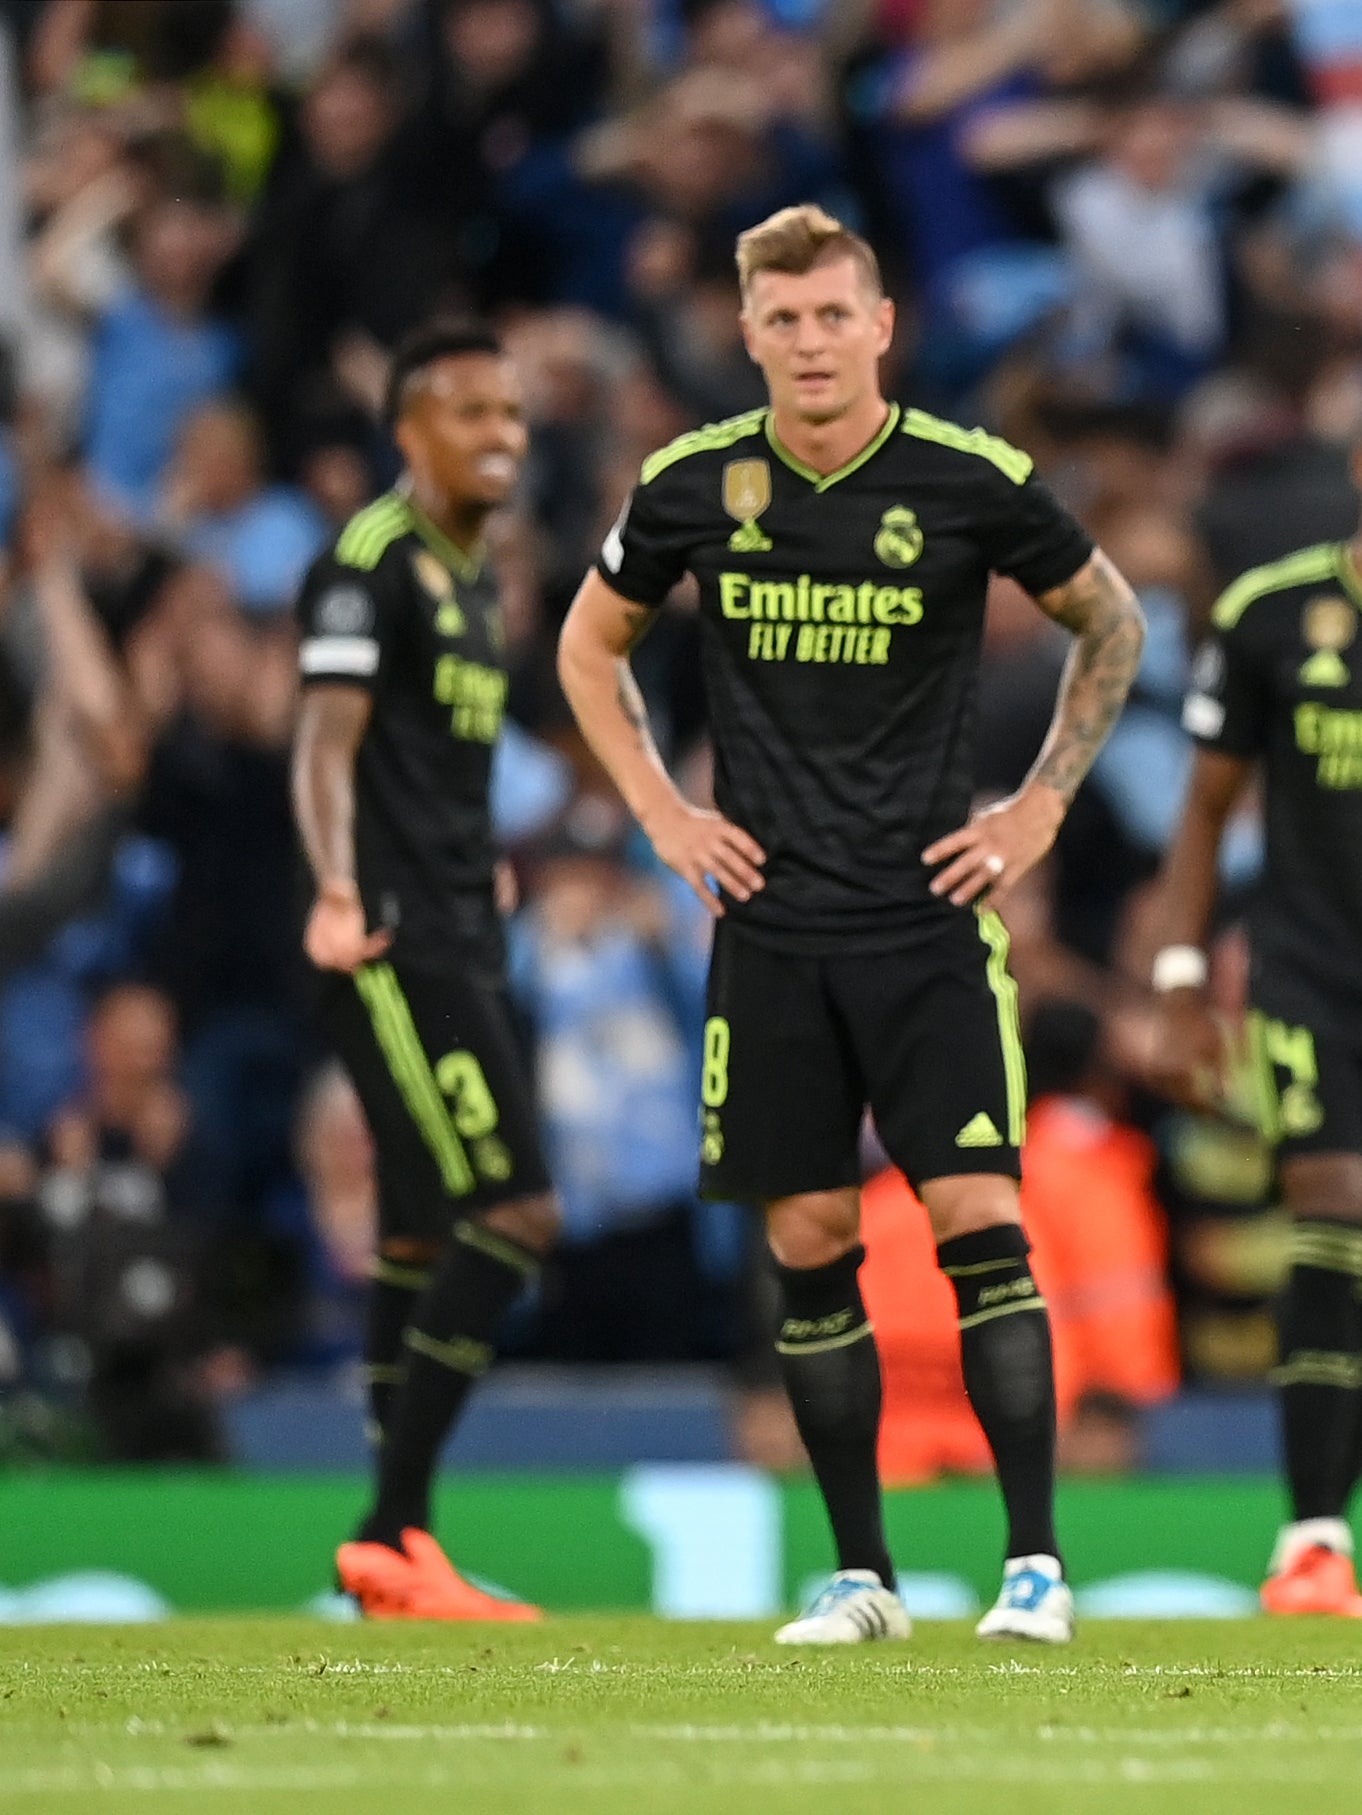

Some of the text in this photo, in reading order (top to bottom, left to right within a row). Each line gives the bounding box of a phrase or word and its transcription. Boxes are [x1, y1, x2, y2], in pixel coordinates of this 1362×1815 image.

[719, 572, 924, 626] Emirates
[748, 621, 891, 665] FLY BETTER
[435, 1049, 498, 1138] 3
[702, 1016, 730, 1108] 8
